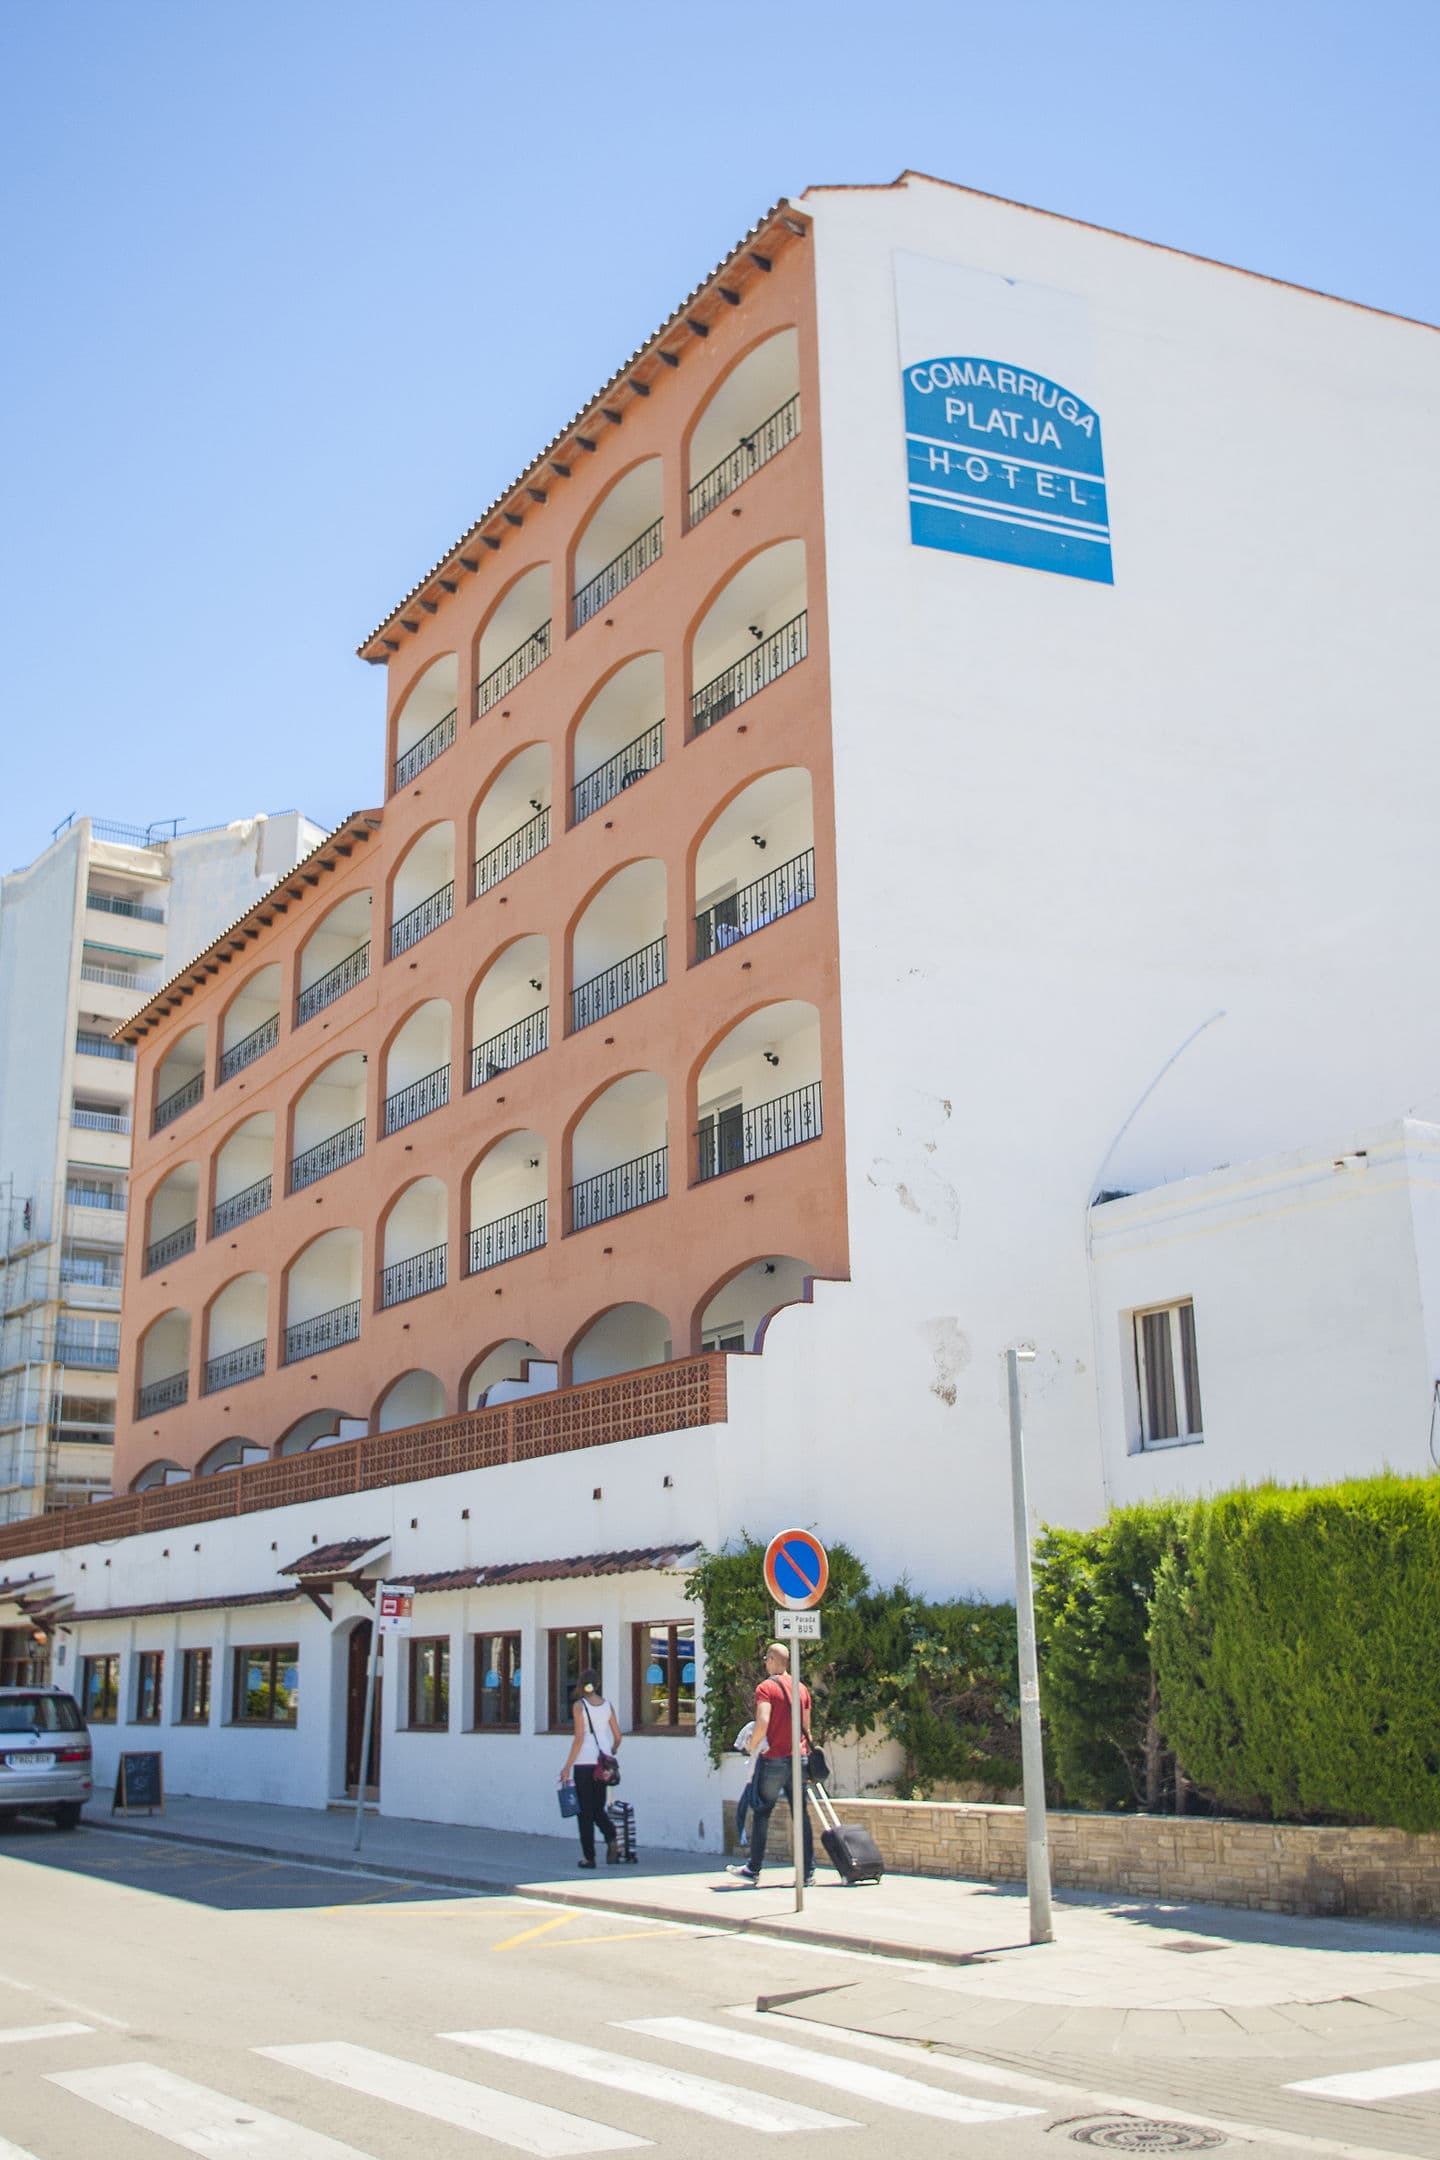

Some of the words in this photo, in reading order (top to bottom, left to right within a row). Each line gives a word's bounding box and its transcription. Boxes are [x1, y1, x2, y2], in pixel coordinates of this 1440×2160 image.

[910, 362, 1096, 438] COMARRUGA
[945, 397, 1062, 449] PLATJA
[929, 448, 1087, 505] HOTEL
[798, 1625, 814, 1633] BUS
